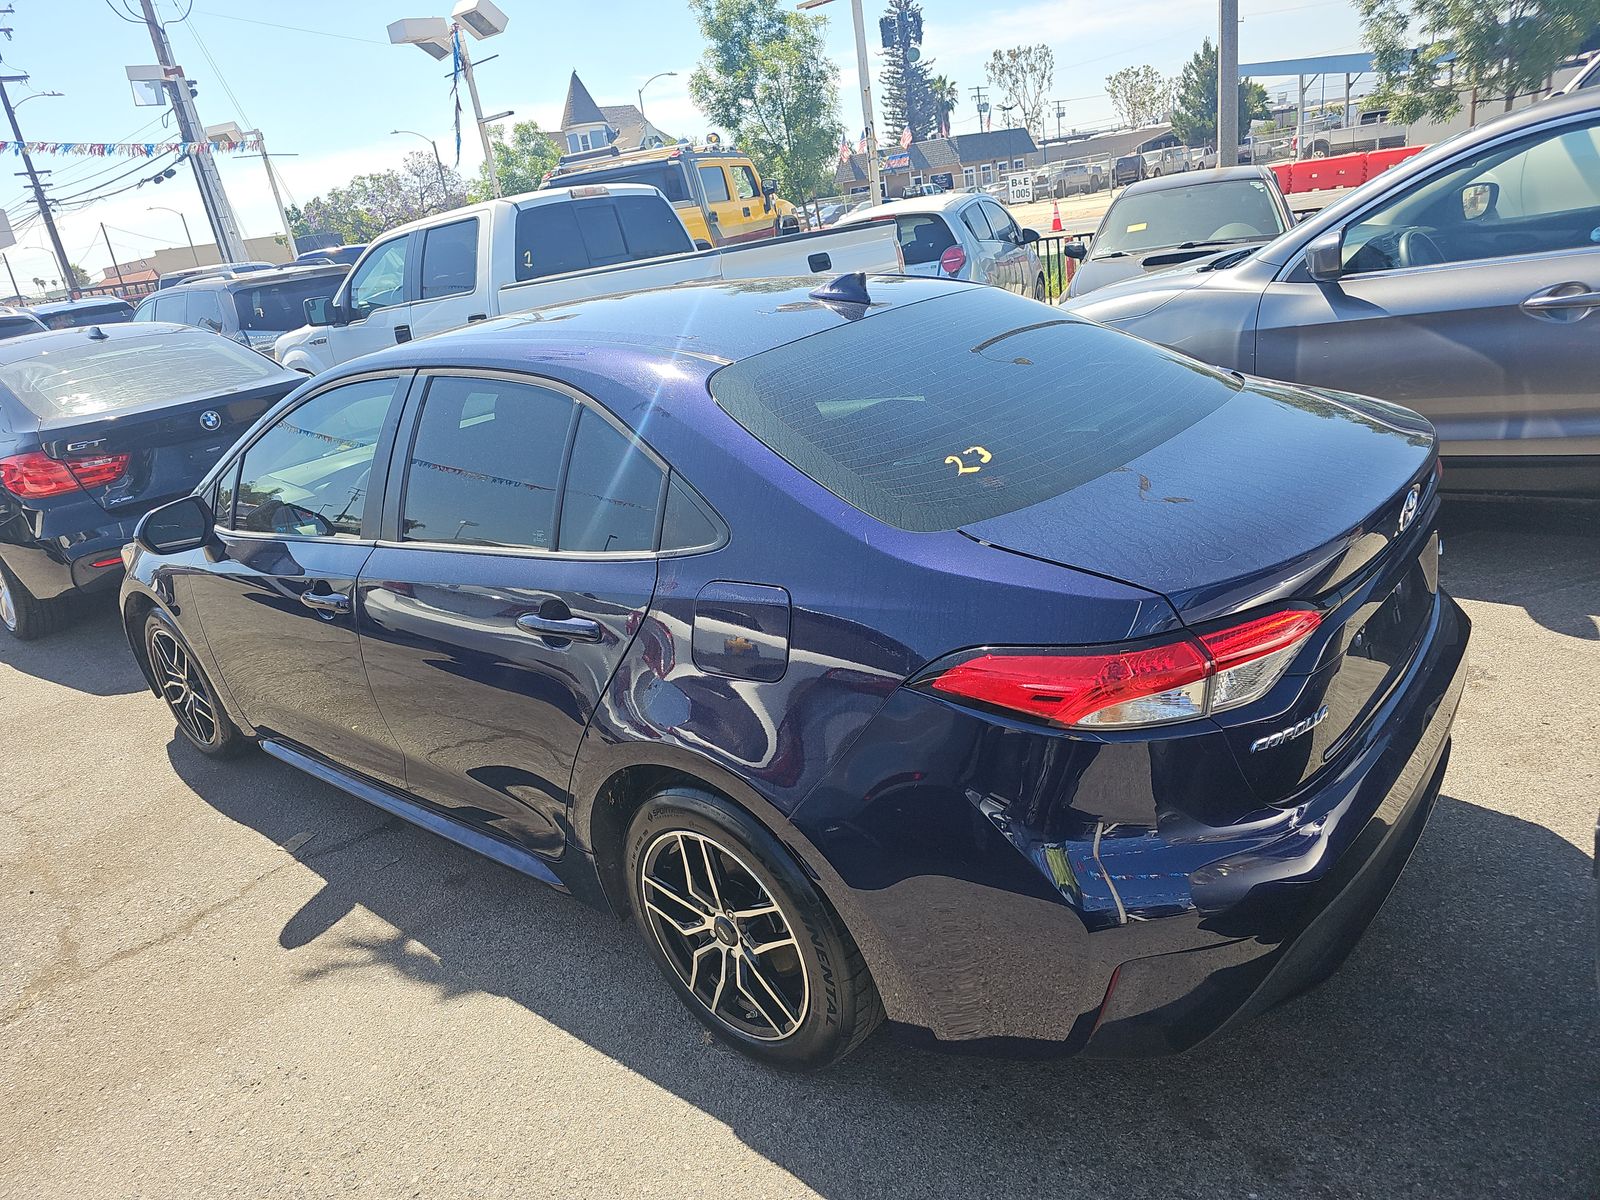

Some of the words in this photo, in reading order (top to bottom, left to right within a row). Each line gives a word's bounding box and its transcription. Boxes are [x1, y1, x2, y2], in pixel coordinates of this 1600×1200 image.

[1011, 189, 1031, 199] 1005
[67, 438, 107, 451] GT
[944, 446, 993, 477] 23
